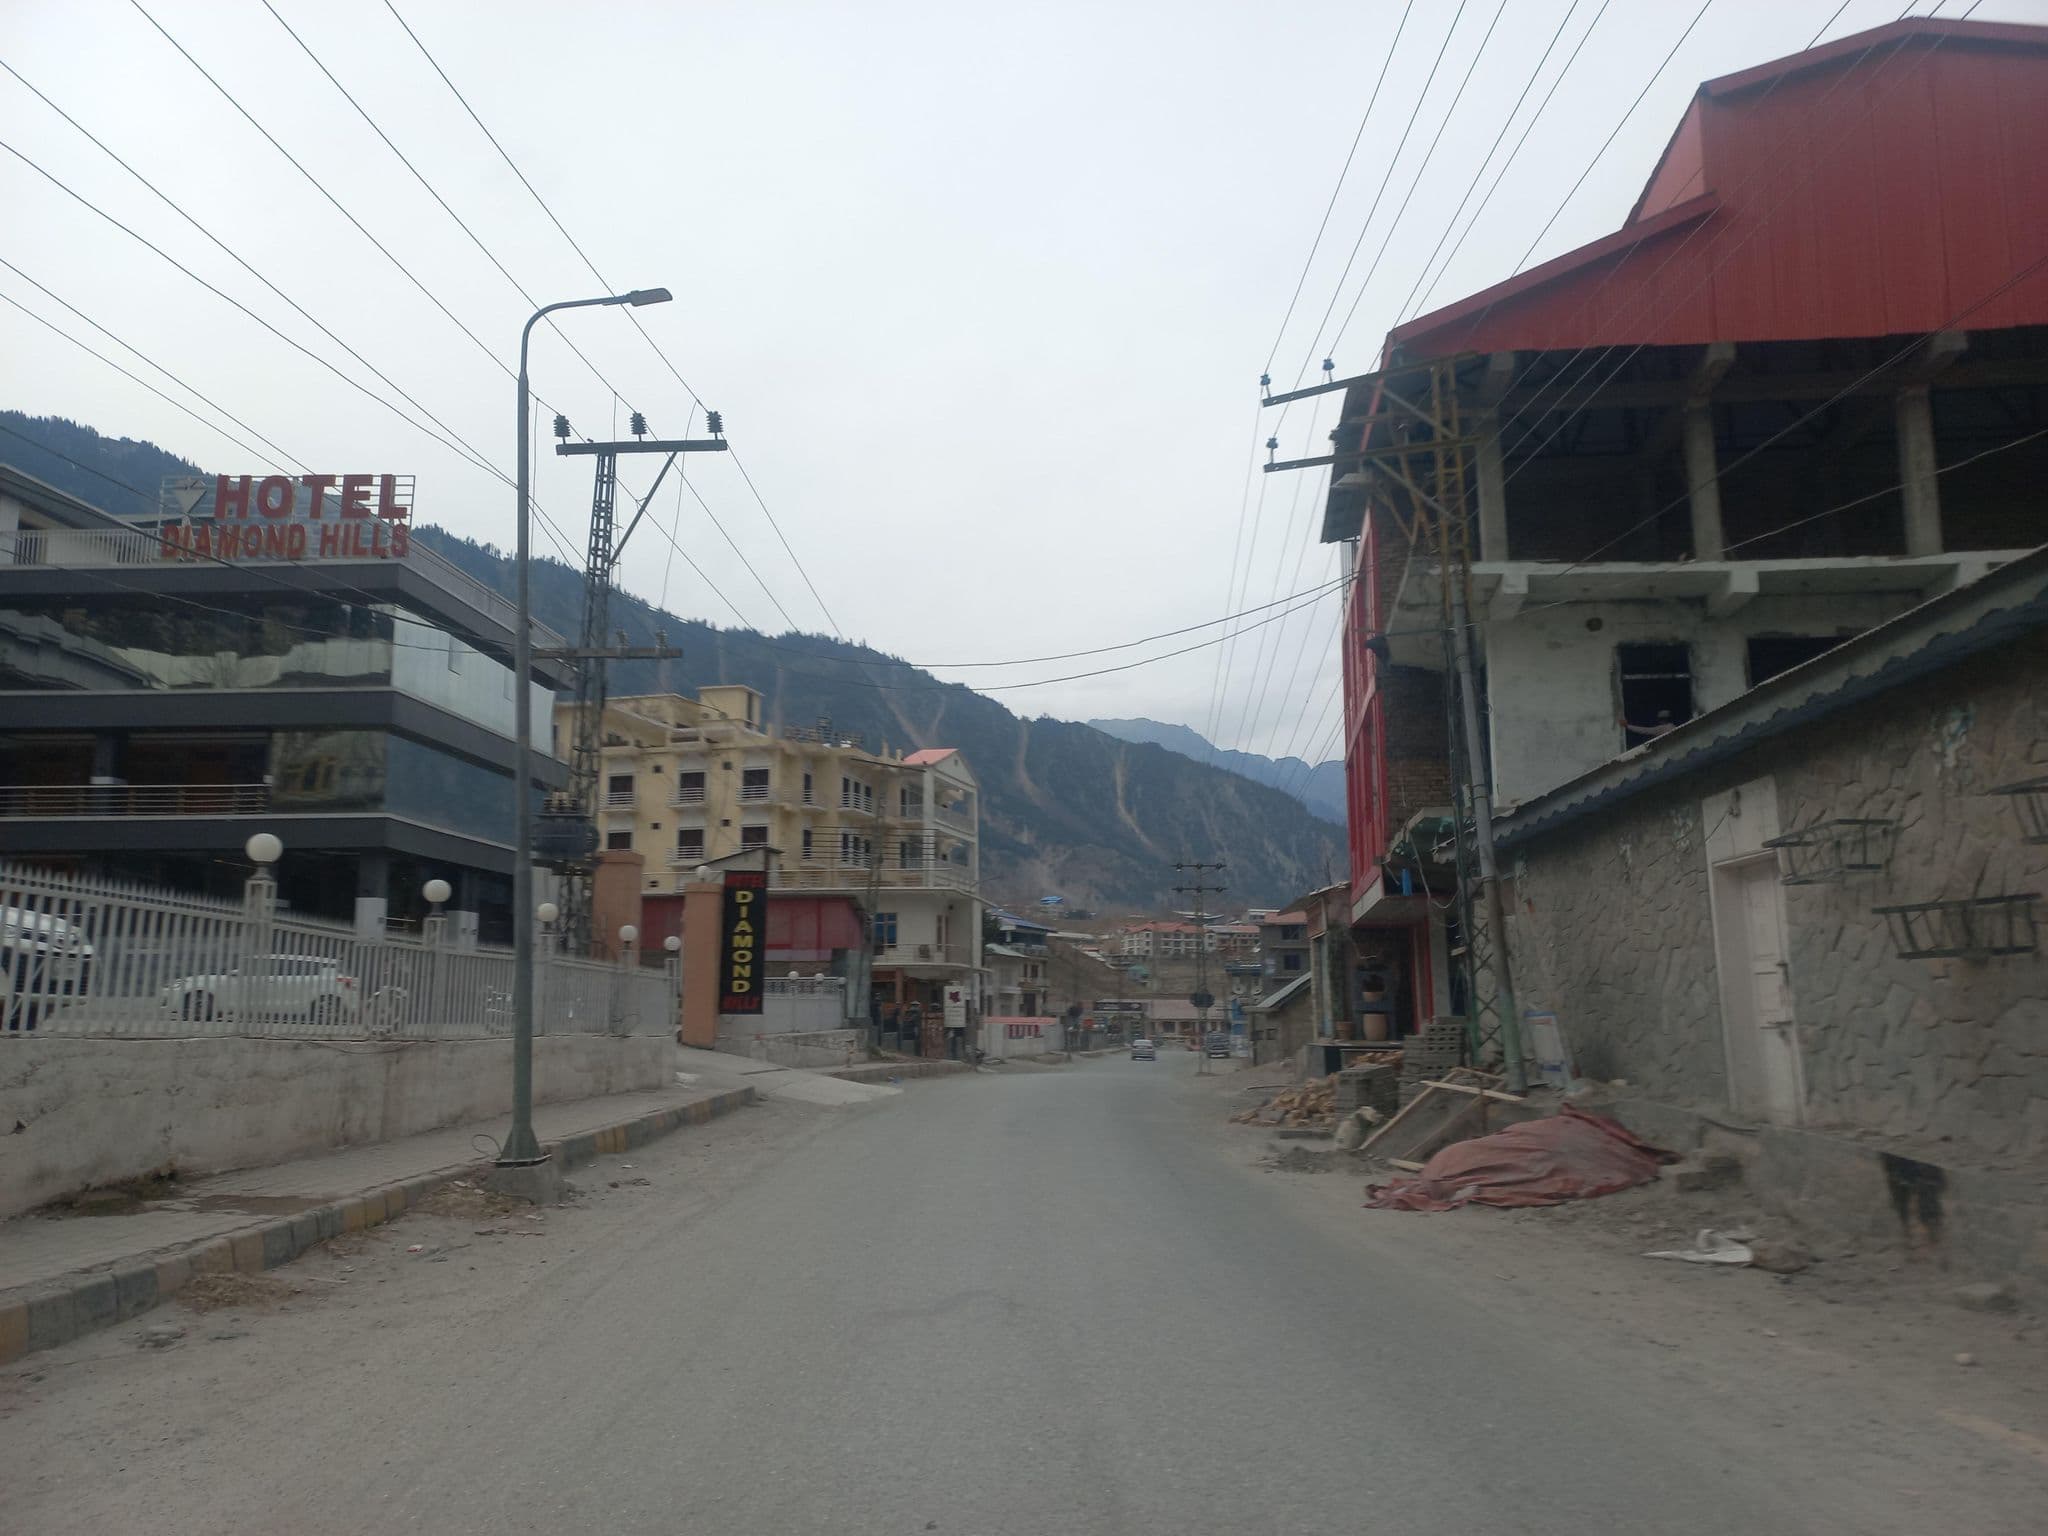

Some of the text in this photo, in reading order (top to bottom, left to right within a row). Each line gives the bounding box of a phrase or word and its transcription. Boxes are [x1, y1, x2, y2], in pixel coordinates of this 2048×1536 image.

[215, 474, 407, 519] HOTEL
[161, 522, 410, 559] DIAMOND HILLS
[731, 890, 754, 993] DIAMOND
